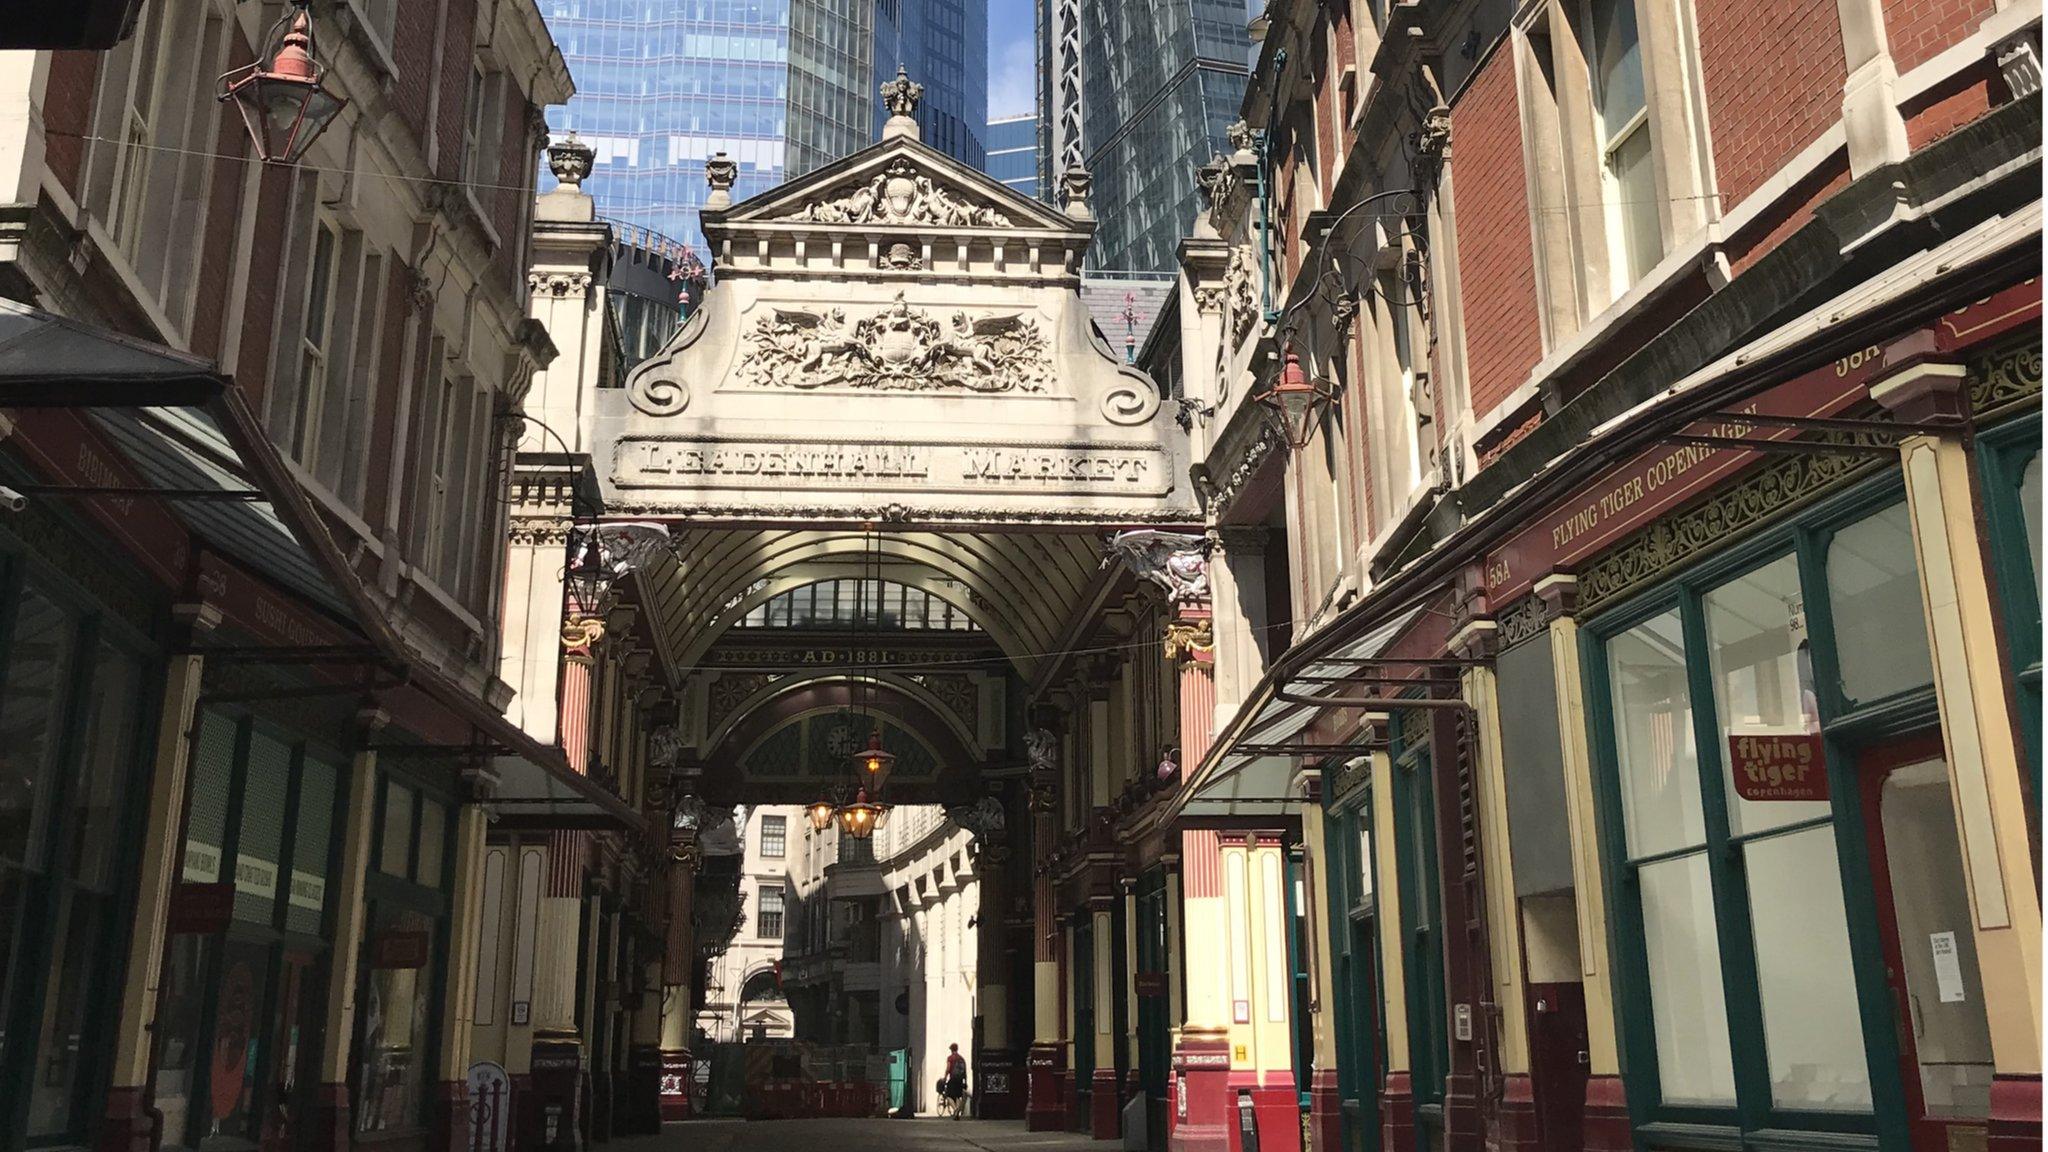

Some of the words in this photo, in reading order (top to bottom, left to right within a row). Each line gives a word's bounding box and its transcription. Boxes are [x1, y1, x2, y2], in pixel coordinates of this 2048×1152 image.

[640, 445, 928, 477] LEADENHALL
[963, 450, 1147, 482] MARKET
[1551, 504, 1598, 550] FLYING
[1600, 478, 1645, 519] TIGER
[1489, 559, 1512, 589] 58A
[255, 596, 287, 635] SUSHI
[1737, 737, 1812, 765] flying
[1744, 760, 1810, 787] tiger
[1236, 1046, 1247, 1061] H
